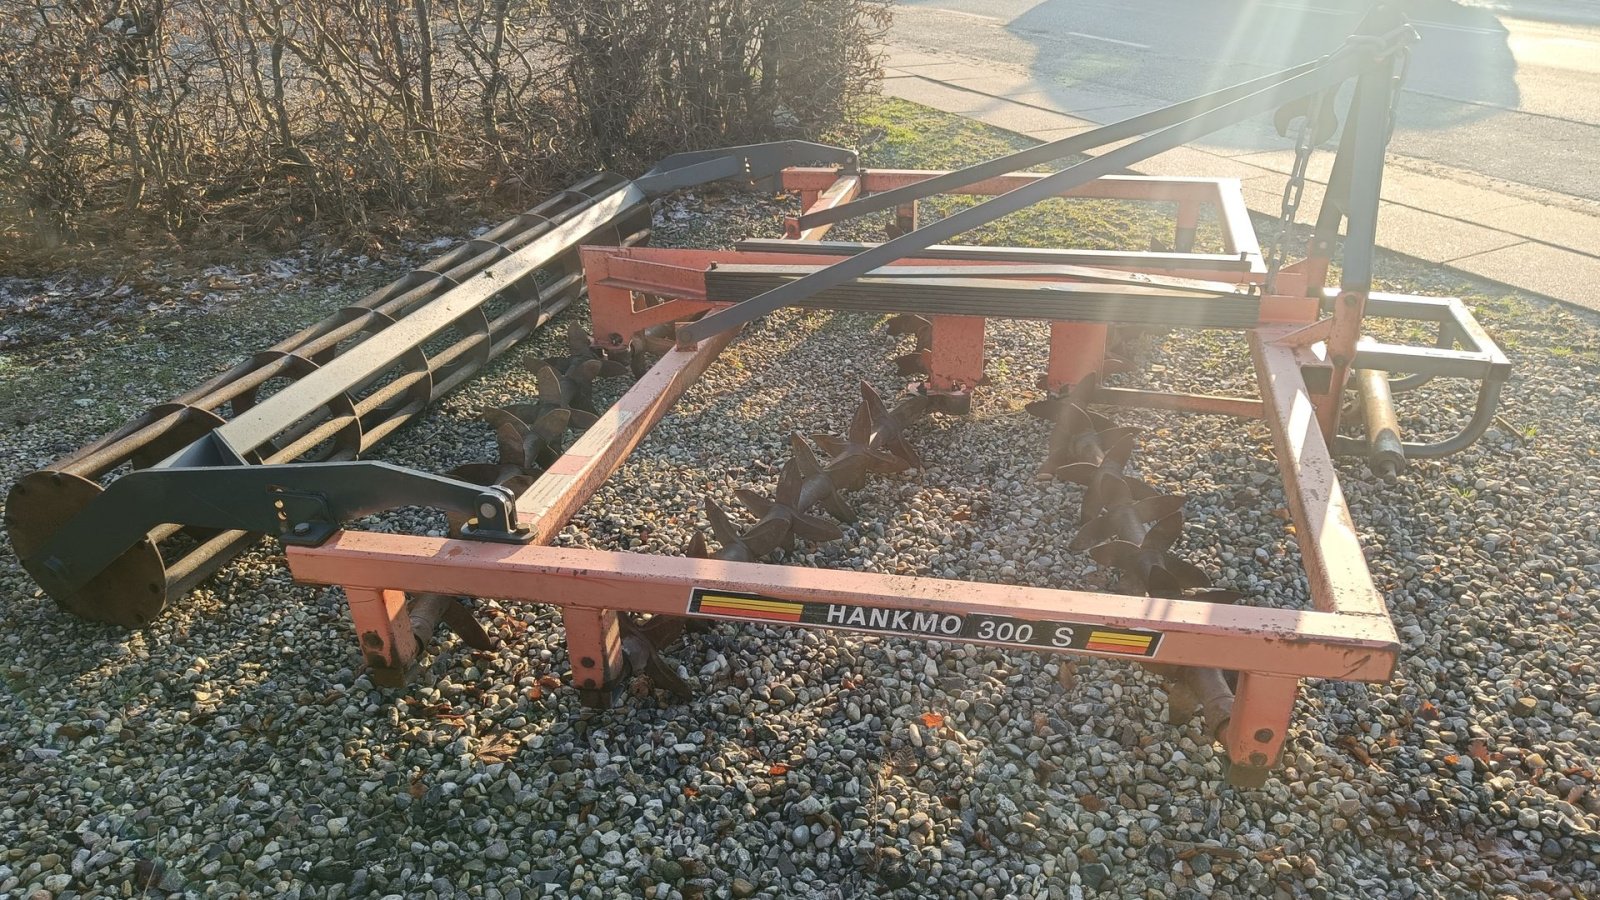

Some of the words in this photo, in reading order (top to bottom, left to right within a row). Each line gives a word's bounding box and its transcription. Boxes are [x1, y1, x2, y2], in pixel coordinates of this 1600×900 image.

[827, 604, 962, 635] HANKMO
[977, 620, 1033, 643] 300
[1051, 627, 1075, 648] S
